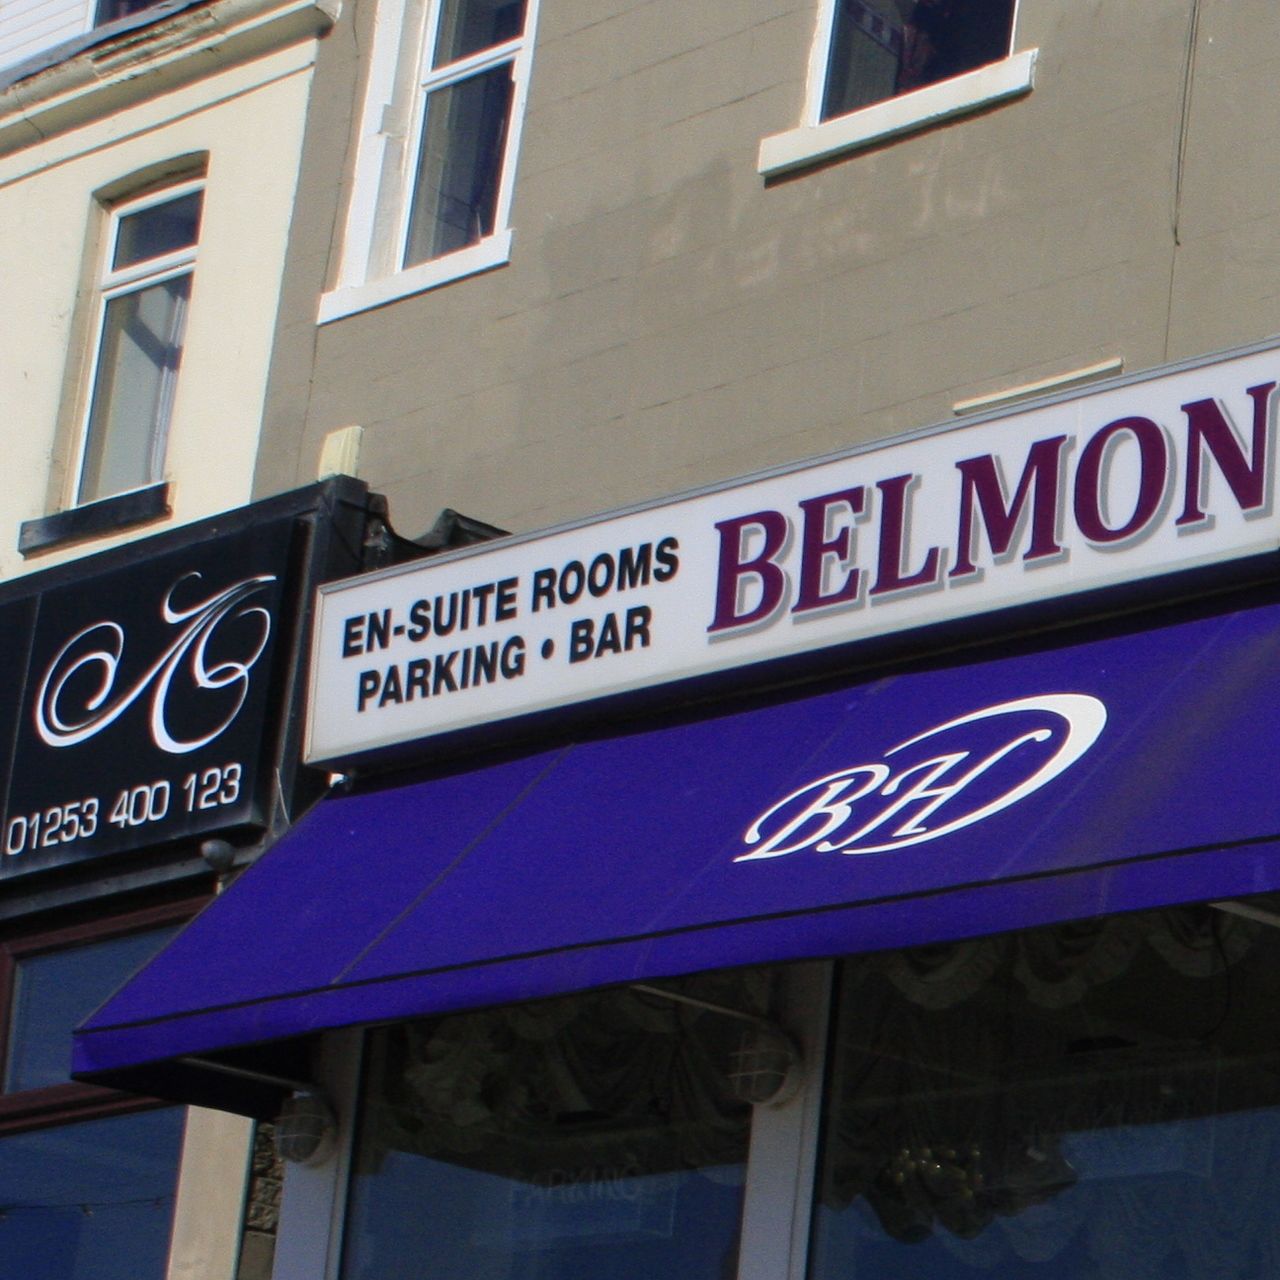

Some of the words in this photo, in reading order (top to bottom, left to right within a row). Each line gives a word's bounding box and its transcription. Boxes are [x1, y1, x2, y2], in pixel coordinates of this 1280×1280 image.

[342, 576, 519, 659] EN-SUITE
[531, 536, 680, 613] ROOMS
[357, 635, 526, 713] PARKING
[568, 605, 652, 664] BAR
[5, 797, 100, 856] 01253
[107, 779, 171, 829] 400
[182, 762, 242, 812] 123
